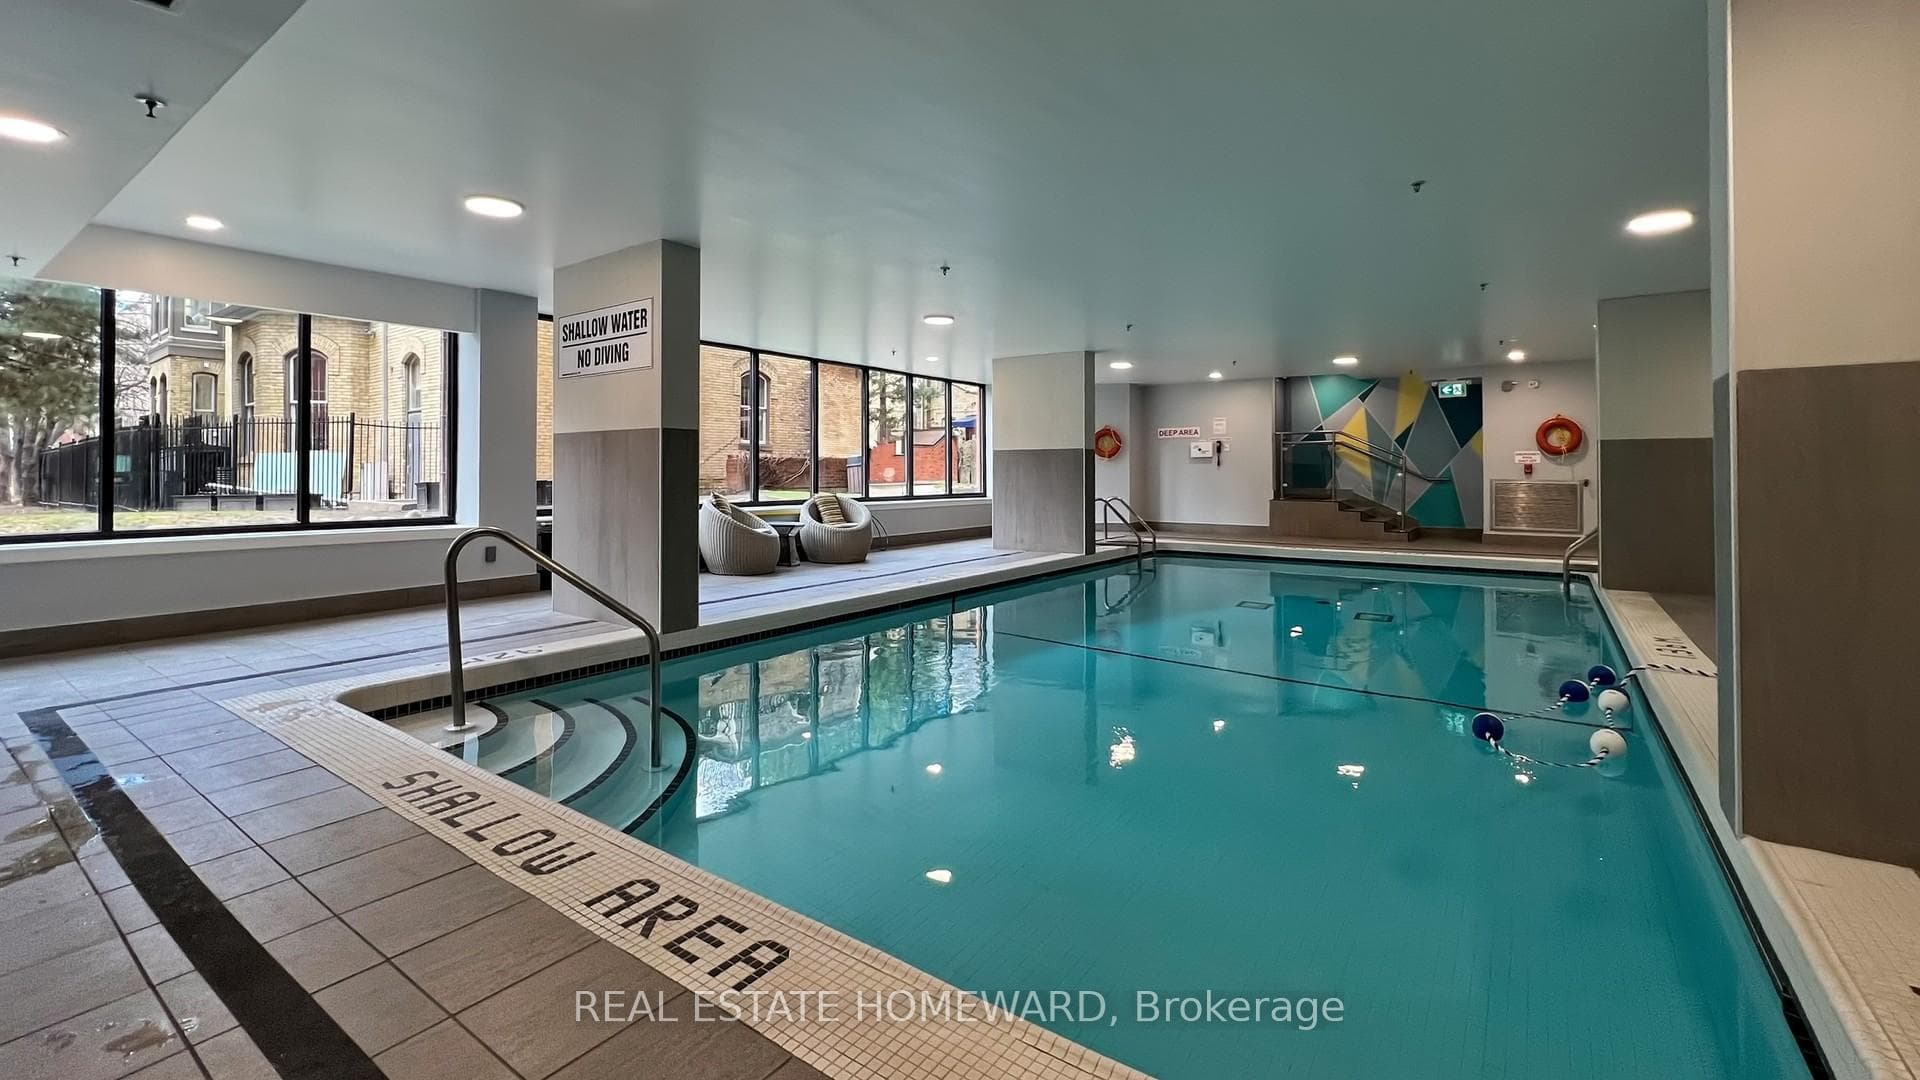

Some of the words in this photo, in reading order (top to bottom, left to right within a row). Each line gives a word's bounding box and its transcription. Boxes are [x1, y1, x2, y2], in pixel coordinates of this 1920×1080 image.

[562, 315, 608, 342] SHALLOW
[611, 308, 648, 333] WATER
[577, 348, 591, 368] NO
[594, 342, 629, 366] DIVING
[1159, 429, 1179, 437] DEEP
[382, 770, 597, 875] SHALLOW
[583, 878, 791, 991] AREA
